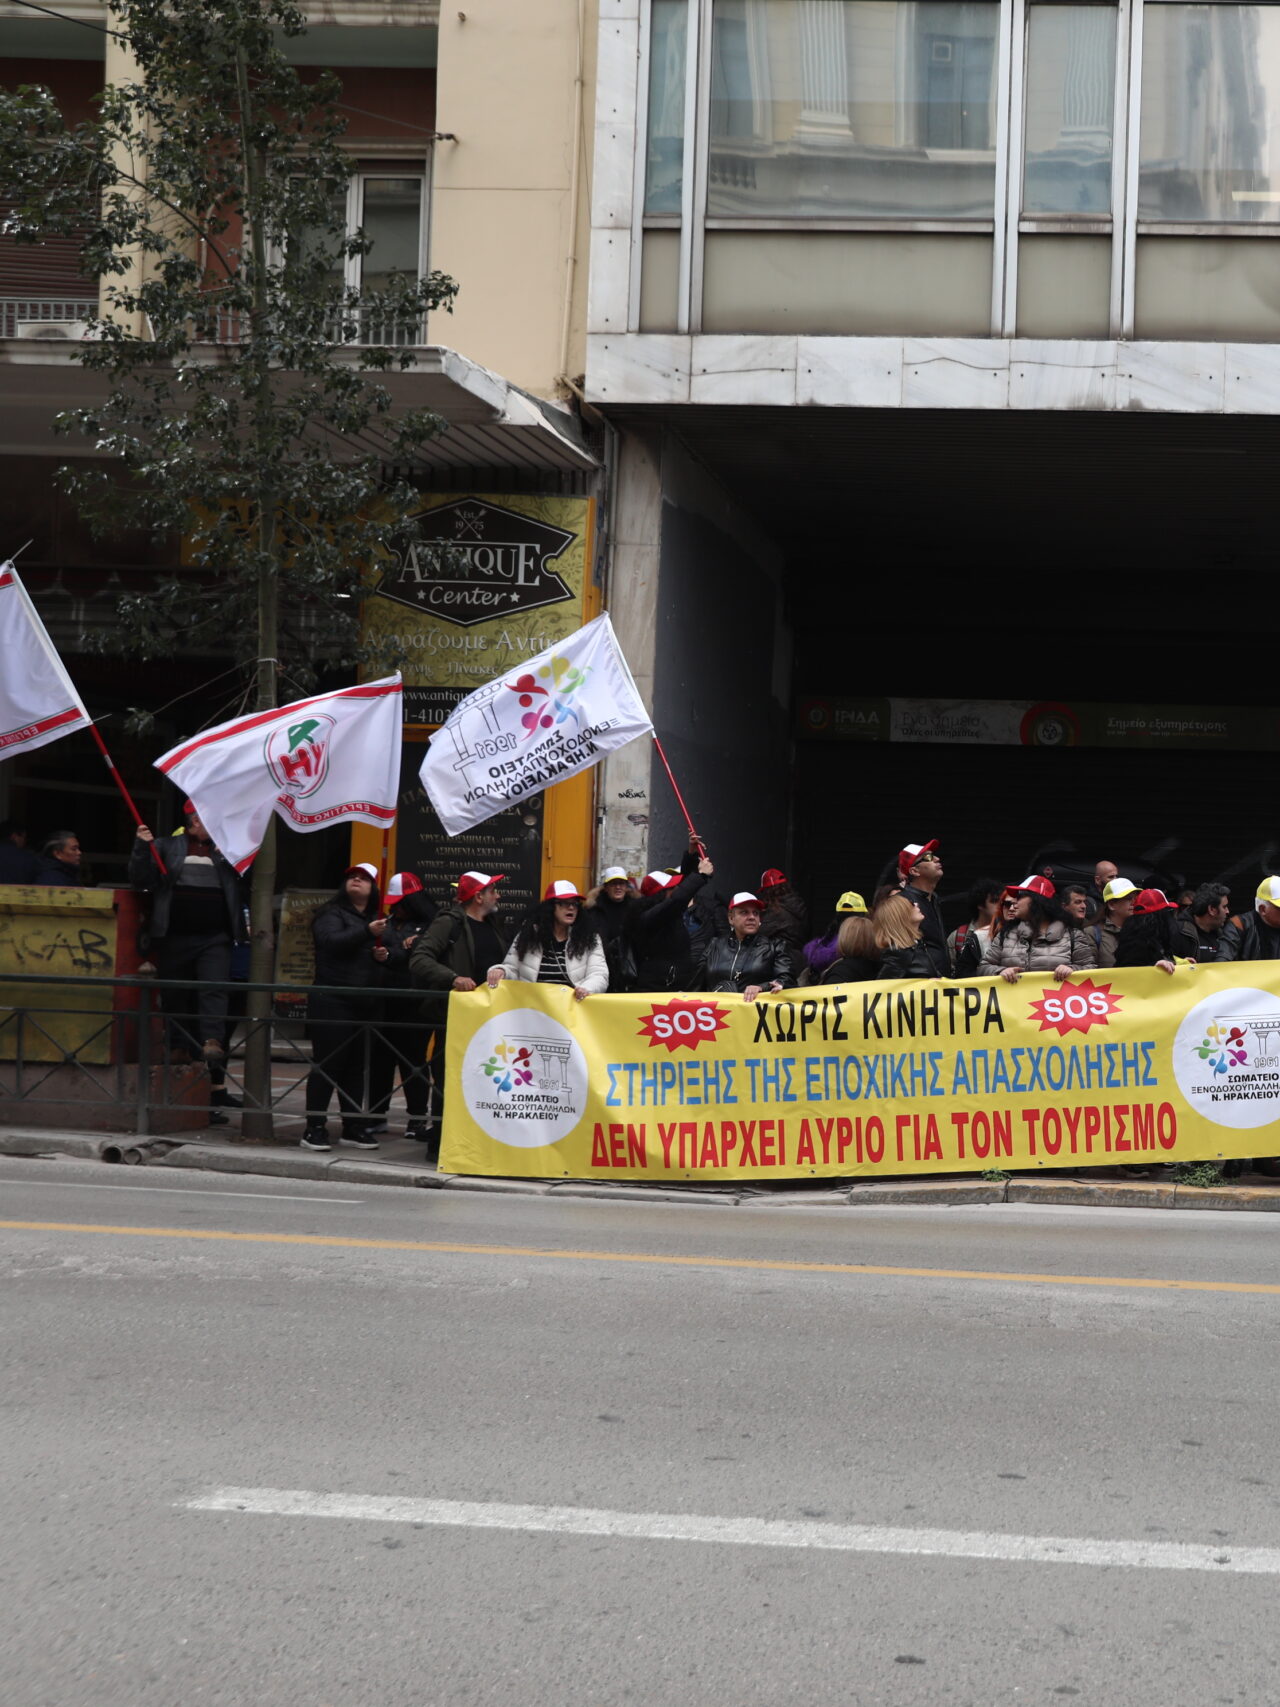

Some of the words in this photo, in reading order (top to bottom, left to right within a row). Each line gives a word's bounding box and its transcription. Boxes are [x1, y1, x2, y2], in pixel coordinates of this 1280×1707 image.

[398, 541, 540, 586] ANIQUE
[429, 585, 506, 606] Center
[496, 630, 559, 651] Αντίκ
[753, 995, 848, 1043] ΧΩΡΙΣ
[863, 986, 1005, 1039] ΚΙΝΗΤΡΑ
[1044, 992, 1109, 1023] SOS
[653, 1006, 717, 1039] SOS
[1254, 1056, 1279, 1068] 1961
[606, 1060, 737, 1107] ΣΤΗΡΙΞΗΣ
[745, 1057, 797, 1103] ΤΗΣ
[806, 1051, 945, 1101] ΕΠΟΧΙΚΗΣ
[952, 1041, 1158, 1095] ΑΠΑΣΧΟΛΗΣΗΣ
[1228, 1073, 1279, 1083] ΣΩΜΑΤΕΙΟ
[511, 1094, 559, 1104] ΣΩΜΑΤΕΙΟ
[1211, 1094, 1222, 1102] Ν.
[1224, 1090, 1280, 1101] ΗΡΑΚΛΕΙΟΥ
[505, 1112, 559, 1120] ΗΡΑΚΛΕΙΟΥ
[591, 1122, 647, 1169] ΔΕΝ
[657, 1119, 786, 1169] ΥΠΑΡΧΕΙ
[796, 1115, 885, 1165] ΑΥΡΙΟ
[896, 1112, 943, 1162] ΓΙΑ
[951, 1109, 1013, 1159] ΤΟΝ
[1022, 1101, 1177, 1155] ΤΟΥΡΙΣΜΟ
